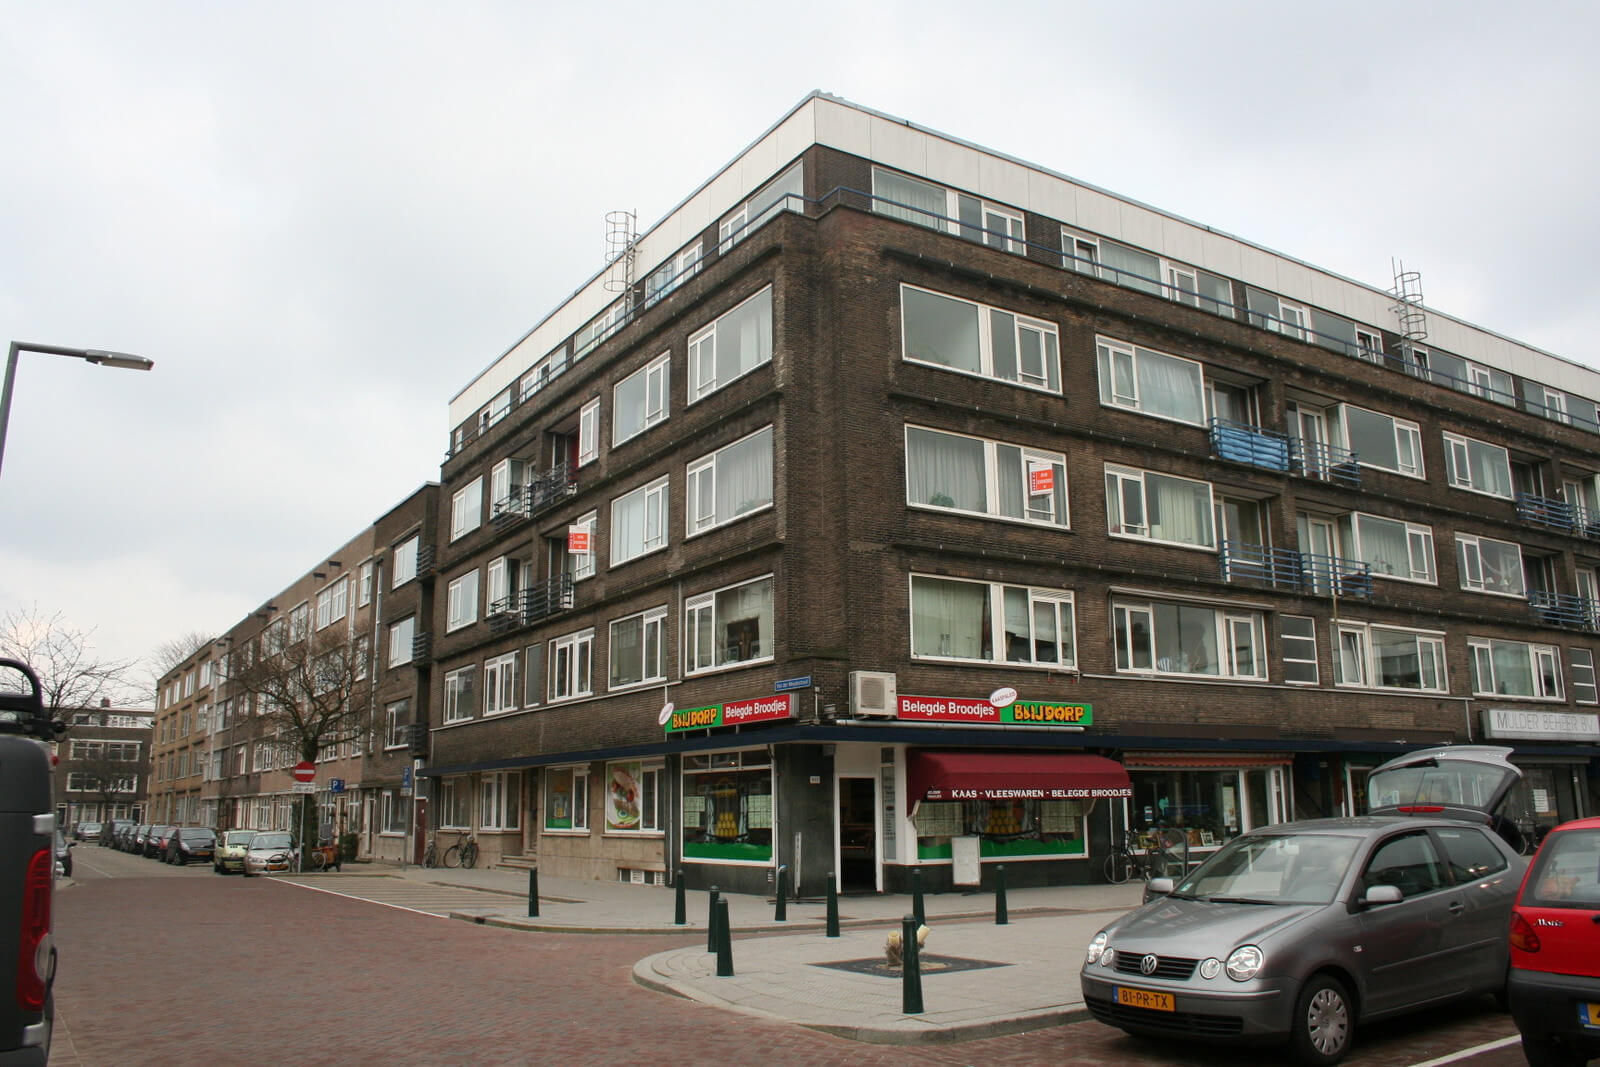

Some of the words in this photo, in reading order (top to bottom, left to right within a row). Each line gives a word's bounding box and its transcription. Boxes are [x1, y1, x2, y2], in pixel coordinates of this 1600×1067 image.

[725, 703, 753, 719] Belegde
[753, 699, 787, 714] Broodjes
[902, 700, 946, 716] Belegde
[948, 702, 995, 718] Broodjes
[1014, 704, 1084, 722] BLIJDORP
[672, 708, 717, 729] BLIJDORP
[1497, 711, 1538, 729] MULDER
[951, 789, 977, 798] KAAS
[985, 789, 1044, 798] VLEESWAREN
[1051, 789, 1090, 798] BELEGDE
[1091, 788, 1132, 797] BROODJES
